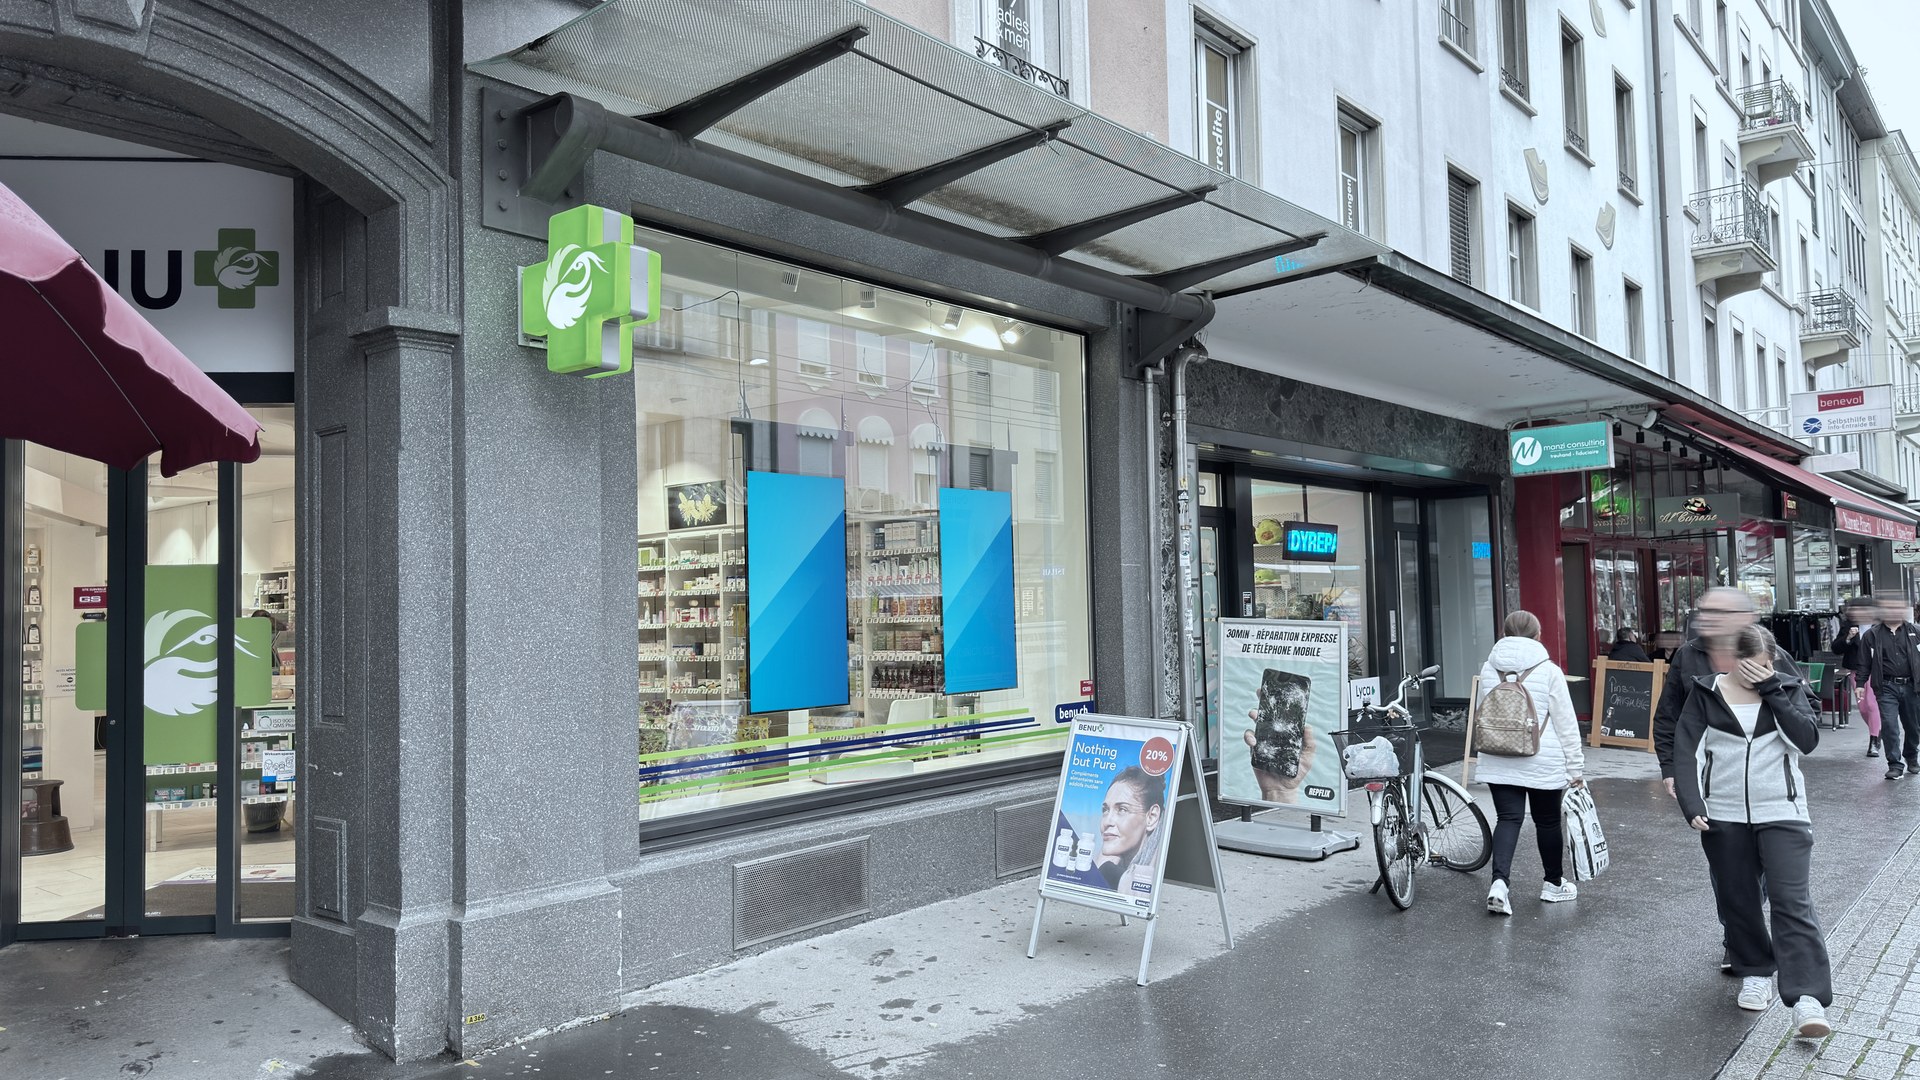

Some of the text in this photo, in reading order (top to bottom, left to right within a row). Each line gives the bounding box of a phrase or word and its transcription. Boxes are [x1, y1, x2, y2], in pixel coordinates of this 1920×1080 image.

[997, 7, 1030, 35] adies
[1005, 28, 1030, 52] men
[1820, 395, 1863, 408] benevol
[1827, 414, 1877, 425] Selbsthilfe BE
[1827, 422, 1868, 431] Info-Entraide
[1543, 438, 1606, 451] manzi consulting
[1550, 449, 1600, 459] treuhand fiduciaire
[1226, 628, 1250, 639] 30MIN
[1256, 628, 1300, 642] RÉPARATION
[1300, 632, 1338, 644] EXPRESSE
[1241, 642, 1321, 657] DE TÉLÉPHONE MOBILE
[1355, 685, 1371, 699] Lyca
[1078, 723, 1097, 733] BENU
[1075, 742, 1118, 760] Nothing
[1145, 749, 1168, 762] 20%
[1072, 754, 1117, 771] but Pure
[1308, 787, 1331, 798] REPFLIX
